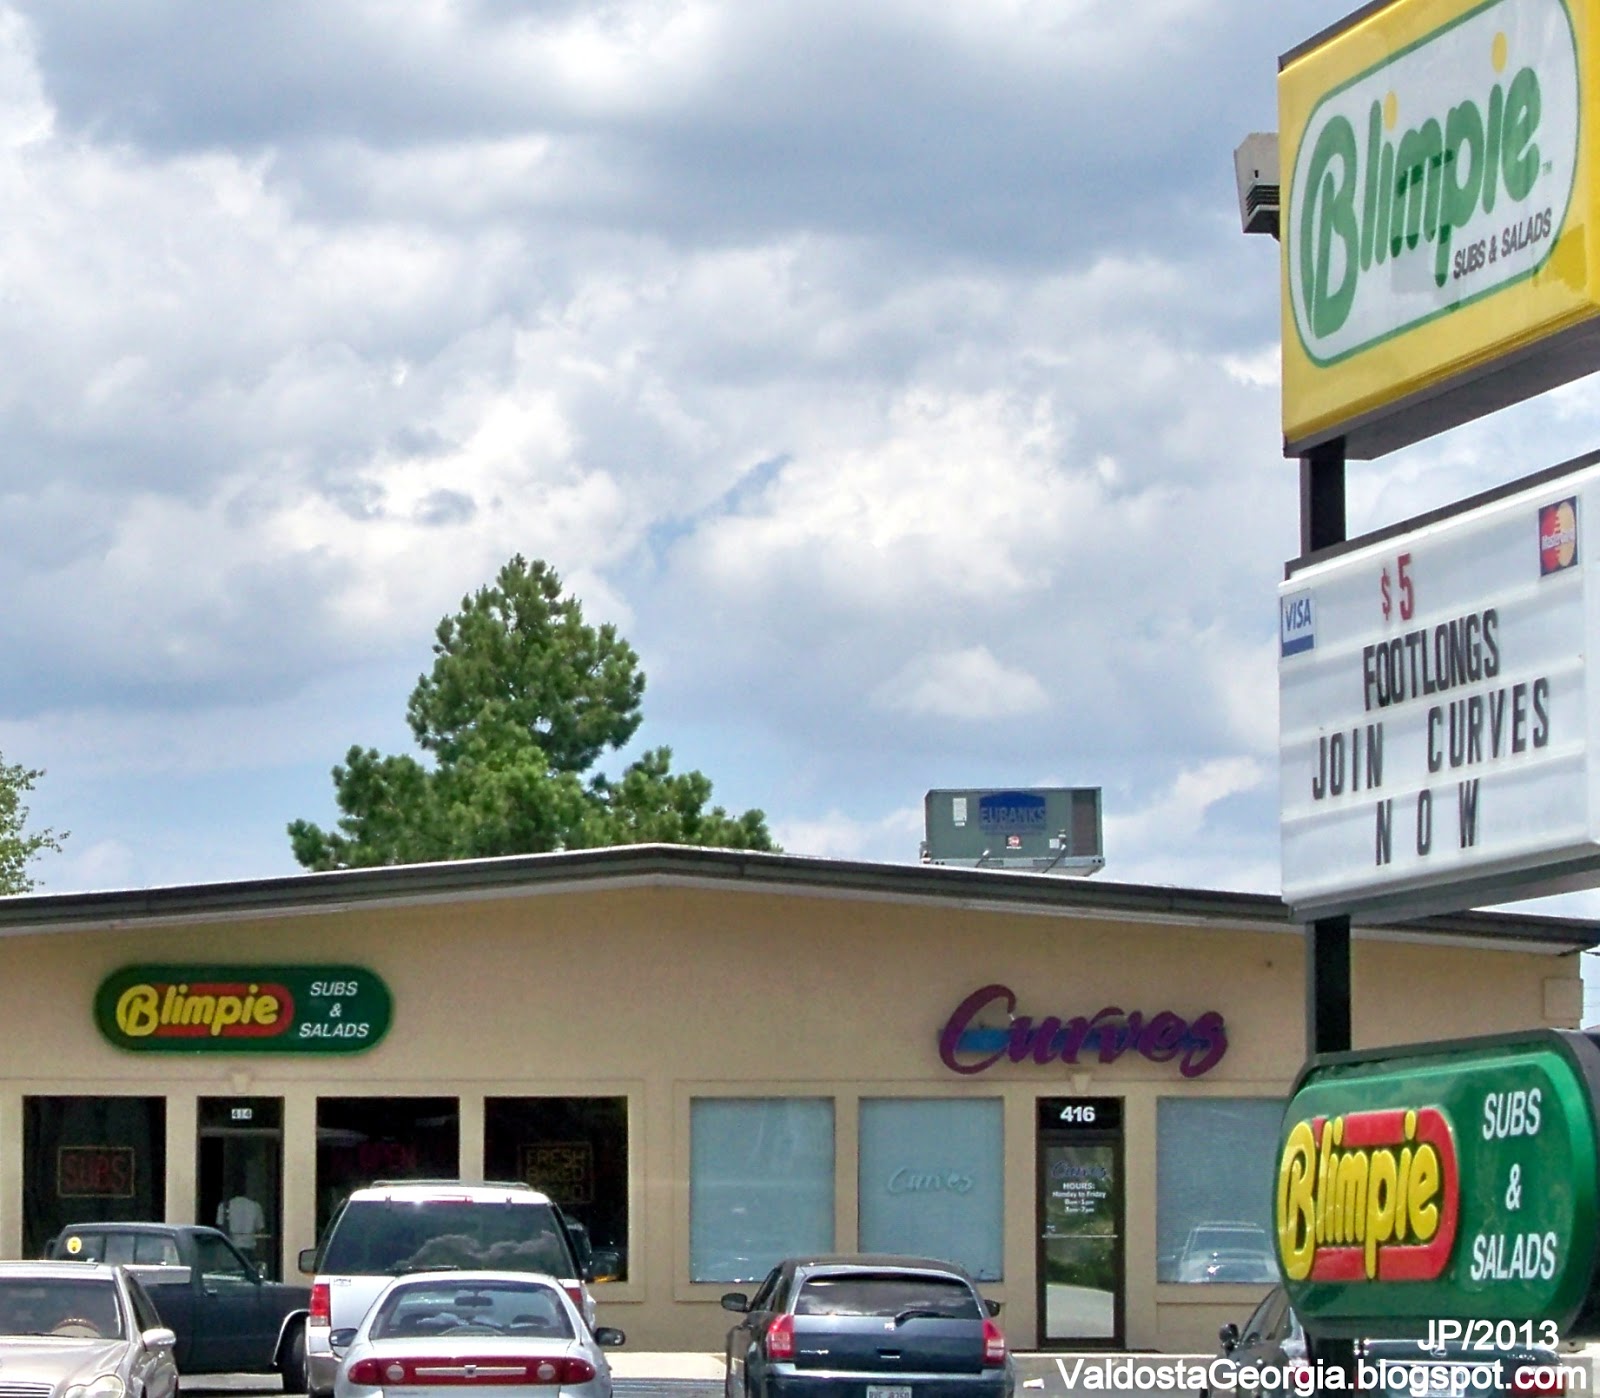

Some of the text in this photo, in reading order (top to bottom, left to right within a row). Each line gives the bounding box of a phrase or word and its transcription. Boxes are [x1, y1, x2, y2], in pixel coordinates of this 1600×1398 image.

[1301, 31, 1541, 339] Blimpie
[1453, 207, 1552, 280] SUBS & SALADS
[1285, 598, 1312, 631] VISA
[1363, 608, 1499, 711] FOOTLONGS
[1312, 677, 1549, 800] JOIN CURVES
[981, 807, 1045, 824] EUBANKS
[116, 983, 278, 1036] Blimpie
[310, 982, 358, 996] SUBS
[330, 1003, 342, 1018] &
[299, 1023, 369, 1037] SALADS
[939, 984, 1229, 1078] Curves
[232, 1109, 252, 1119] 414
[1060, 1106, 1096, 1121] 416
[1482, 1088, 1542, 1140] SUBS
[1276, 1110, 1440, 1281] Blimpie
[1505, 1163, 1521, 1211] &
[1471, 1232, 1557, 1281] SALADS
